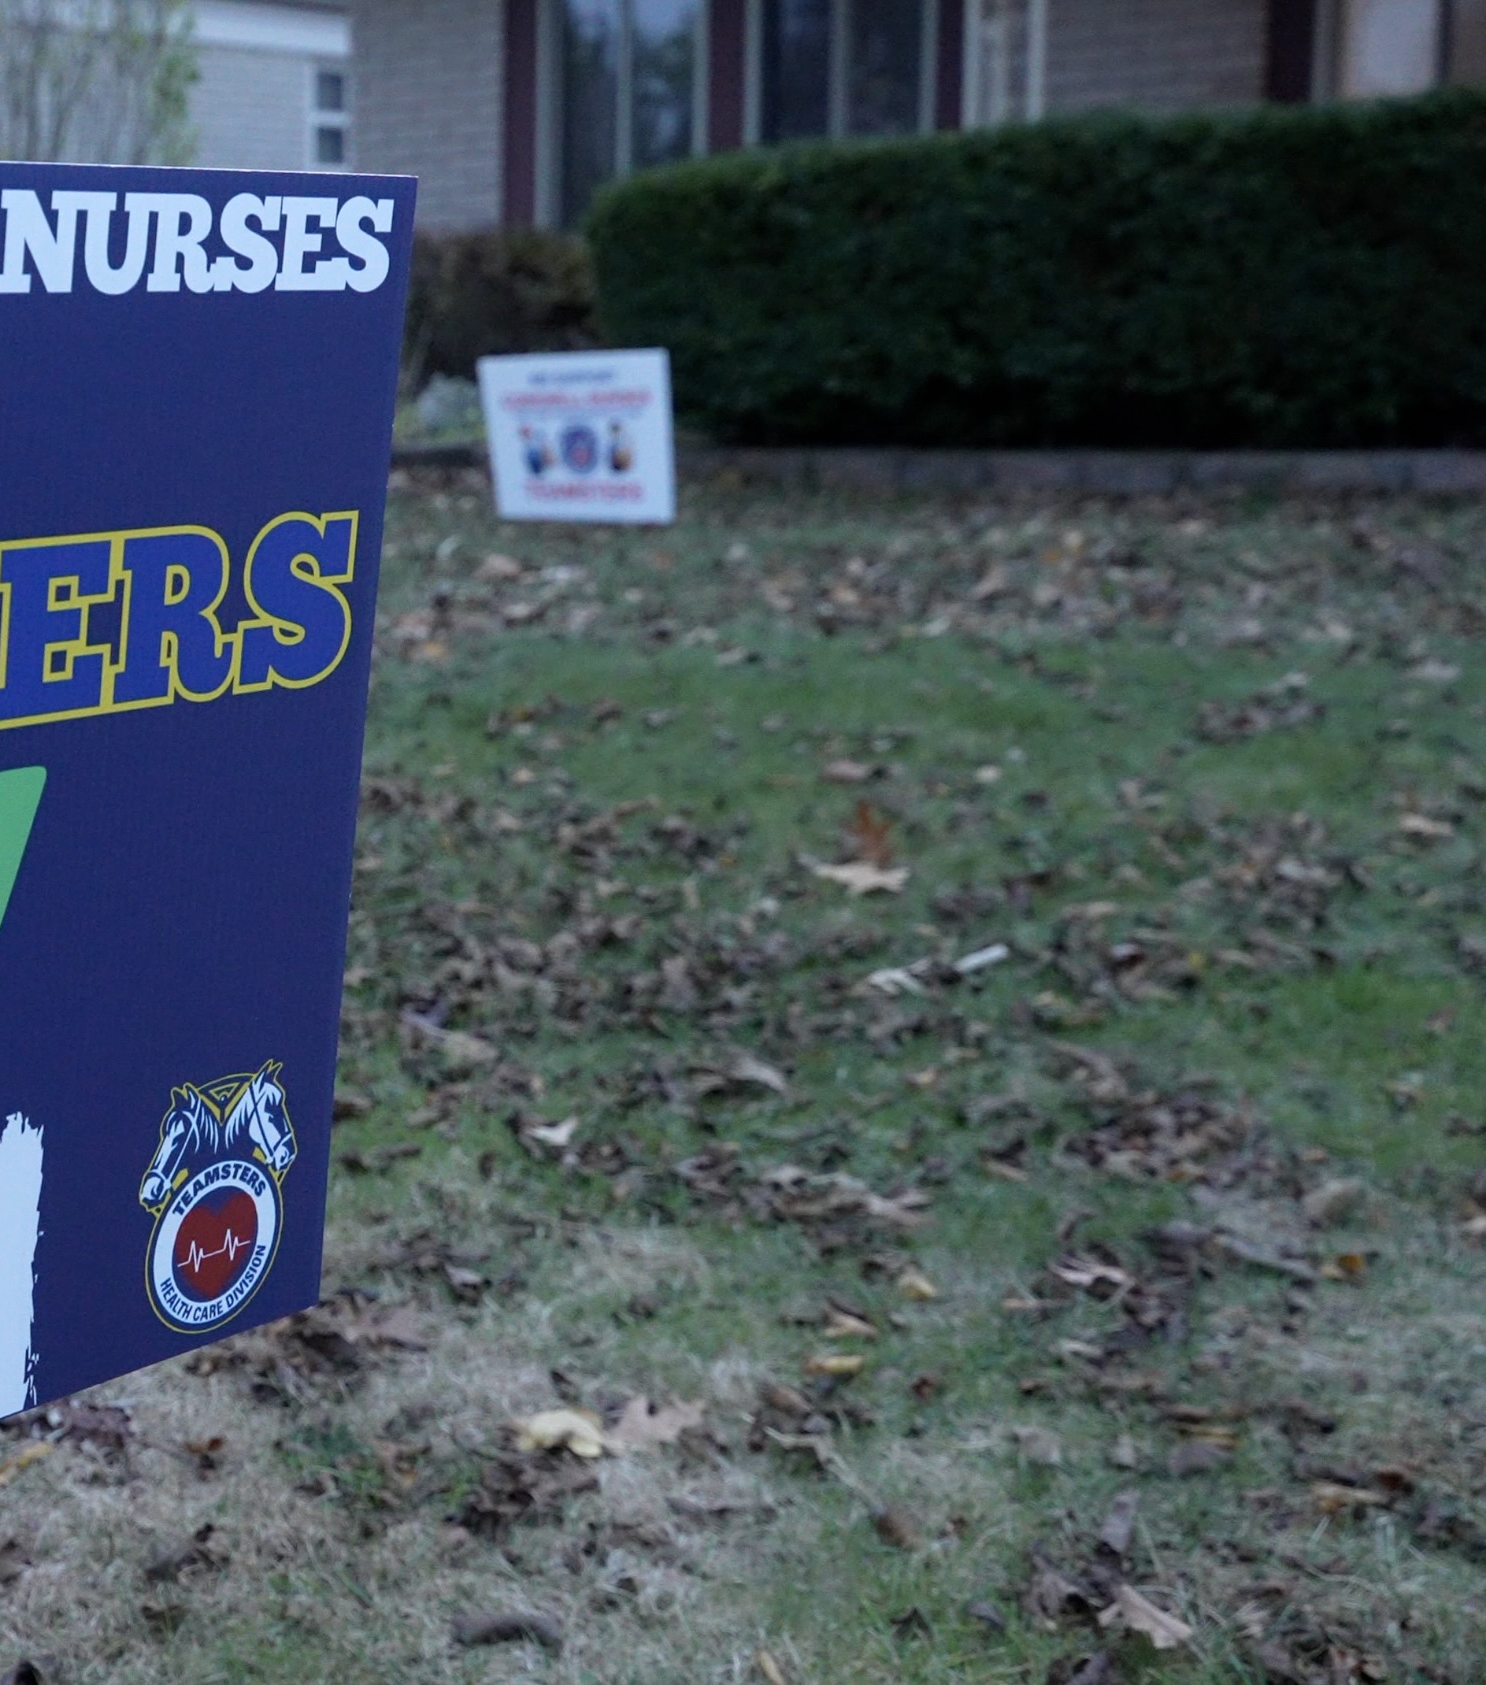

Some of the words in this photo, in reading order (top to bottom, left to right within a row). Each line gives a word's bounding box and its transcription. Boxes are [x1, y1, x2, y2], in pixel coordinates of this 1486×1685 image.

[172, 1163, 267, 1217] TEAMSTERS
[160, 1276, 193, 1321] HEALTH
[193, 1299, 224, 1321] CARE
[225, 1244, 267, 1309] DIVISION
